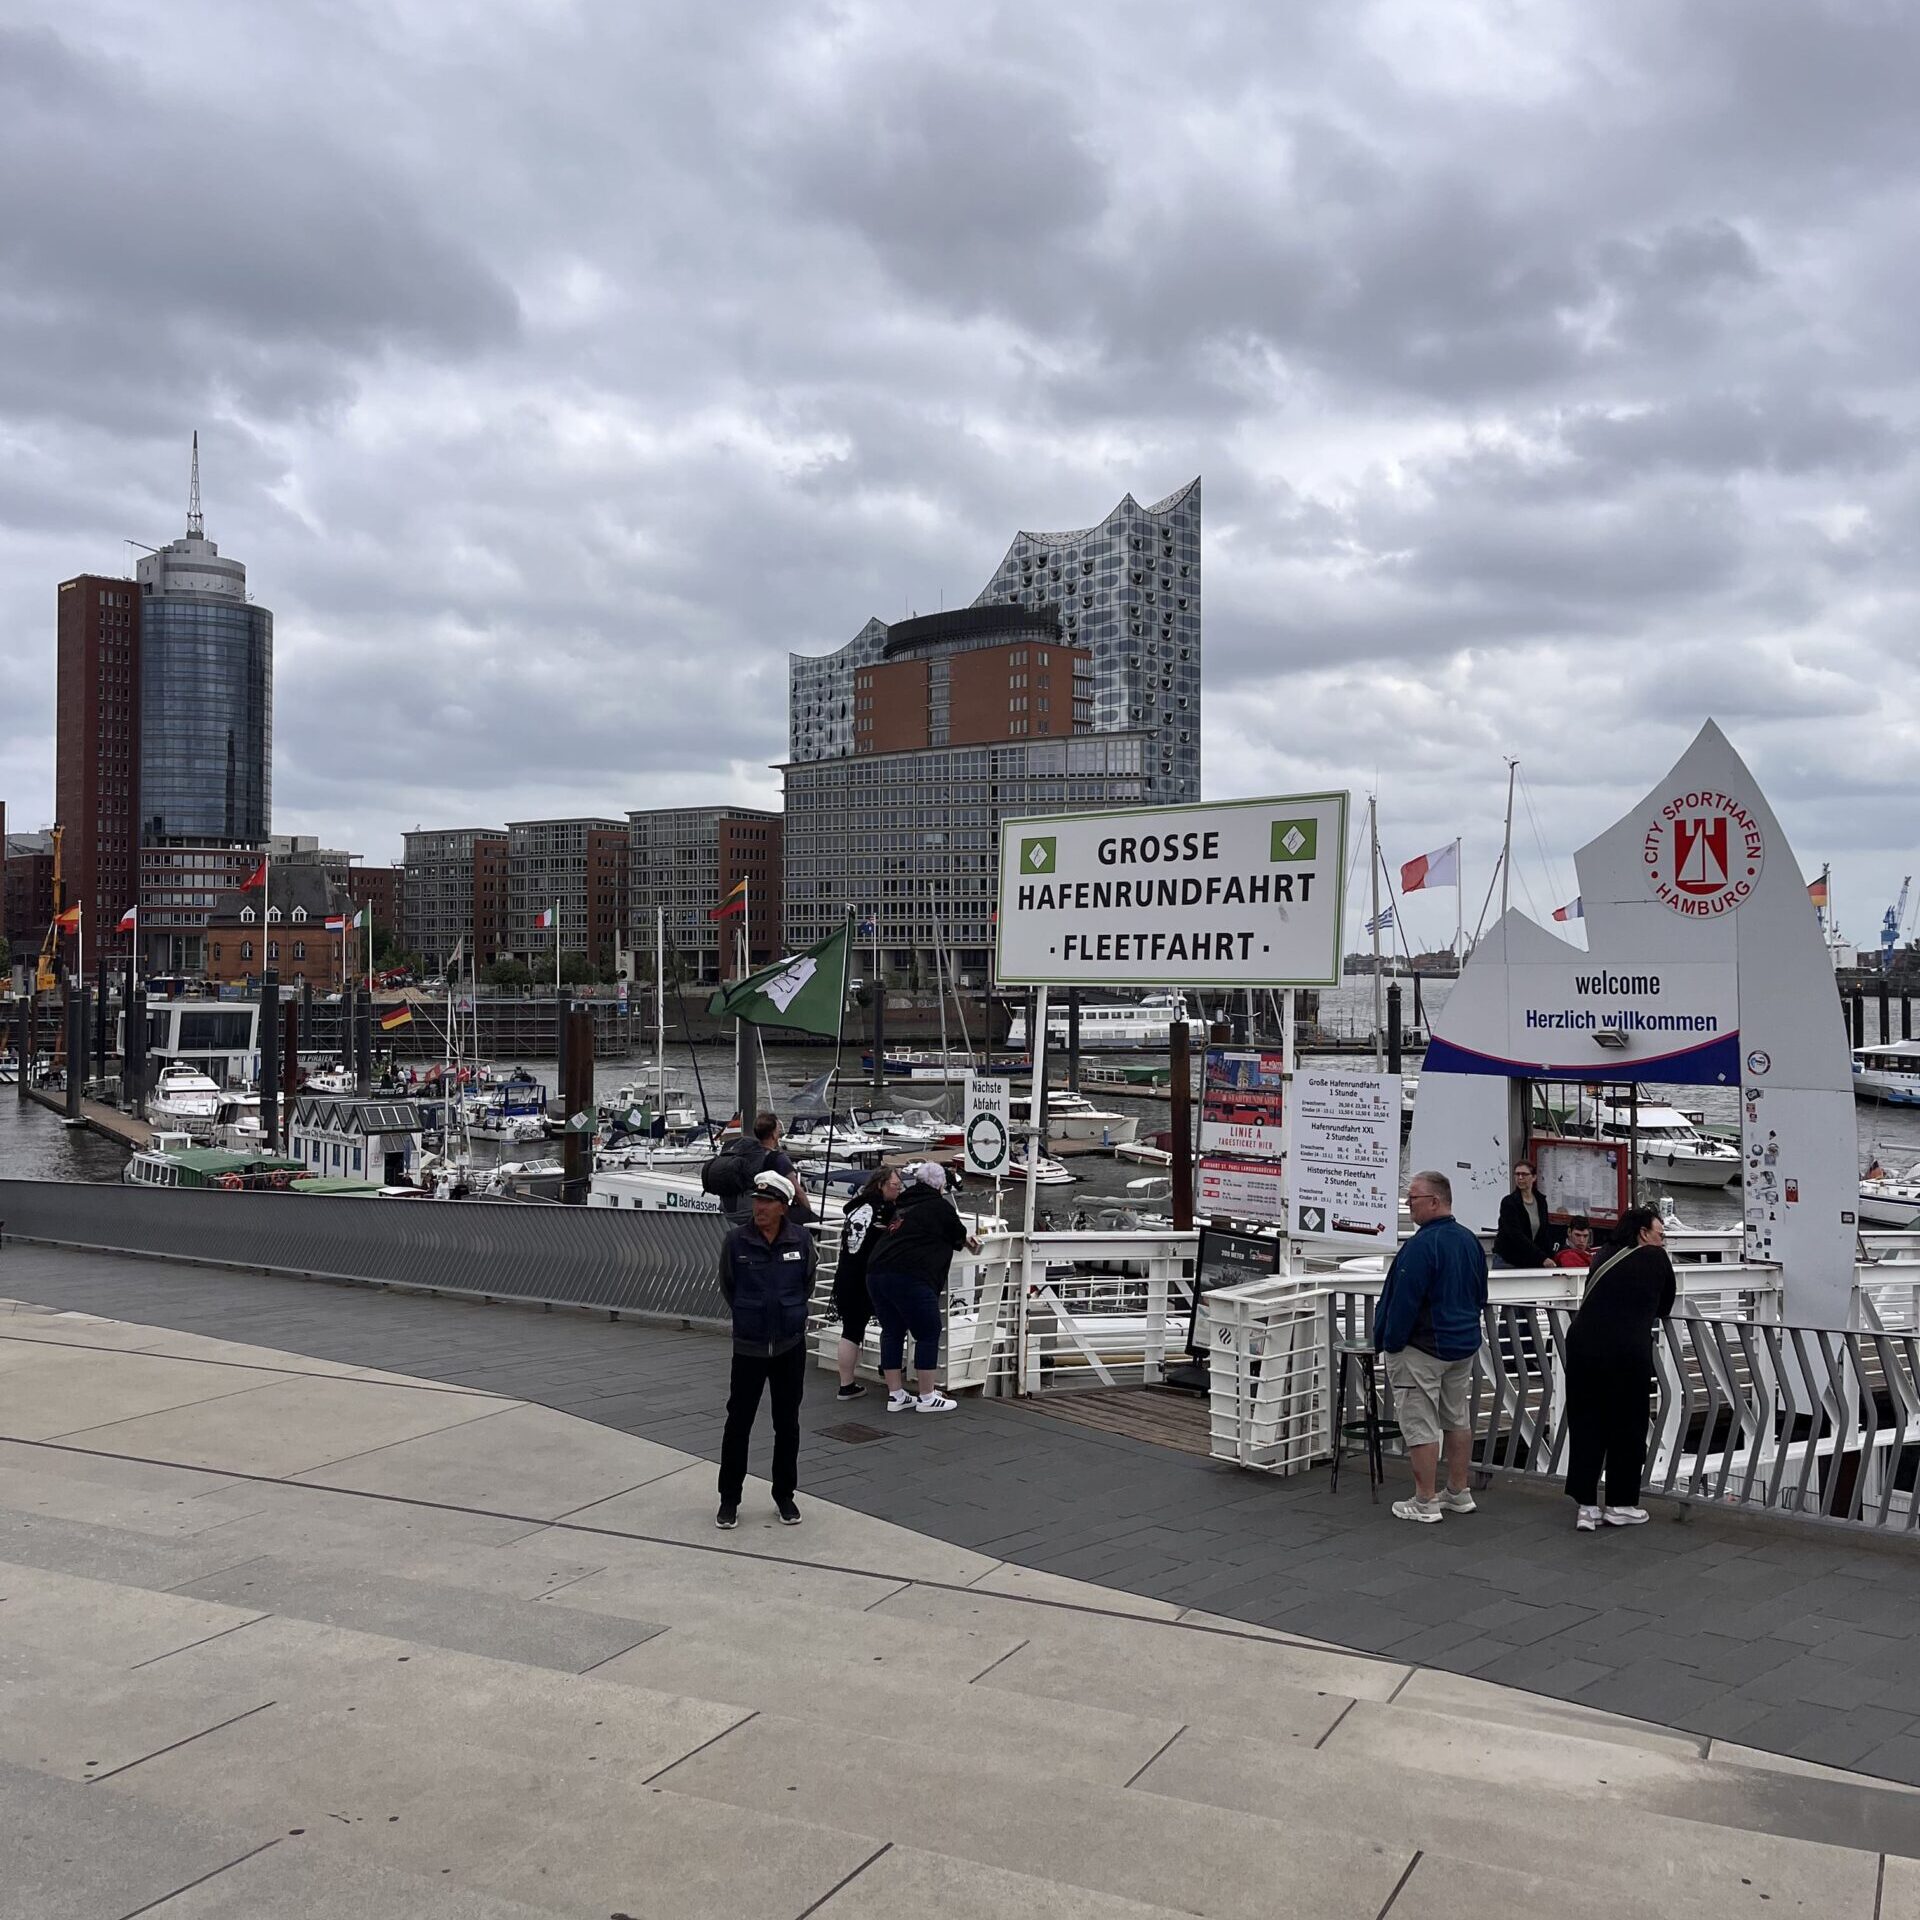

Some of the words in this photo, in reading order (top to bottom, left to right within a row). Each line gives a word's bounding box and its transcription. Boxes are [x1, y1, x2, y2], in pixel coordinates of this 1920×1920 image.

[1644, 820, 1664, 864] CITY
[1662, 791, 1761, 859] SPORTHAFEN
[1098, 832, 1220, 865] GROSSE
[1018, 873, 1315, 911] HAFENRUNDFAHRT
[1655, 880, 1751, 915] HAMBURG
[1063, 932, 1254, 961] FLEETFAHRT
[1575, 970, 1660, 995] welcome
[1526, 1009, 1596, 1029] Herzlich
[1602, 1010, 1718, 1031] willkommen
[972, 1080, 1002, 1094] Nächste
[1308, 1078, 1328, 1087] Große
[1329, 1079, 1380, 1090] Hafenrundfahrt
[1334, 1089, 1358, 1098] Stunde
[972, 1098, 1001, 1111] Abfahrt
[1230, 1126, 1253, 1138] LINIE
[1256, 1128, 1261, 1138] A
[1311, 1122, 1361, 1134] Hafenrundfahrt
[1362, 1126, 1375, 1134] XXL
[1218, 1137, 1256, 1148] TAGESTICKET
[1258, 1141, 1273, 1150] HIER
[1325, 1132, 1330, 1140] 2
[1331, 1133, 1359, 1142] Stunden
[1307, 1166, 1342, 1176] Historische
[1343, 1169, 1376, 1180] Fleetfahrt
[1330, 1177, 1357, 1187] Stunden
